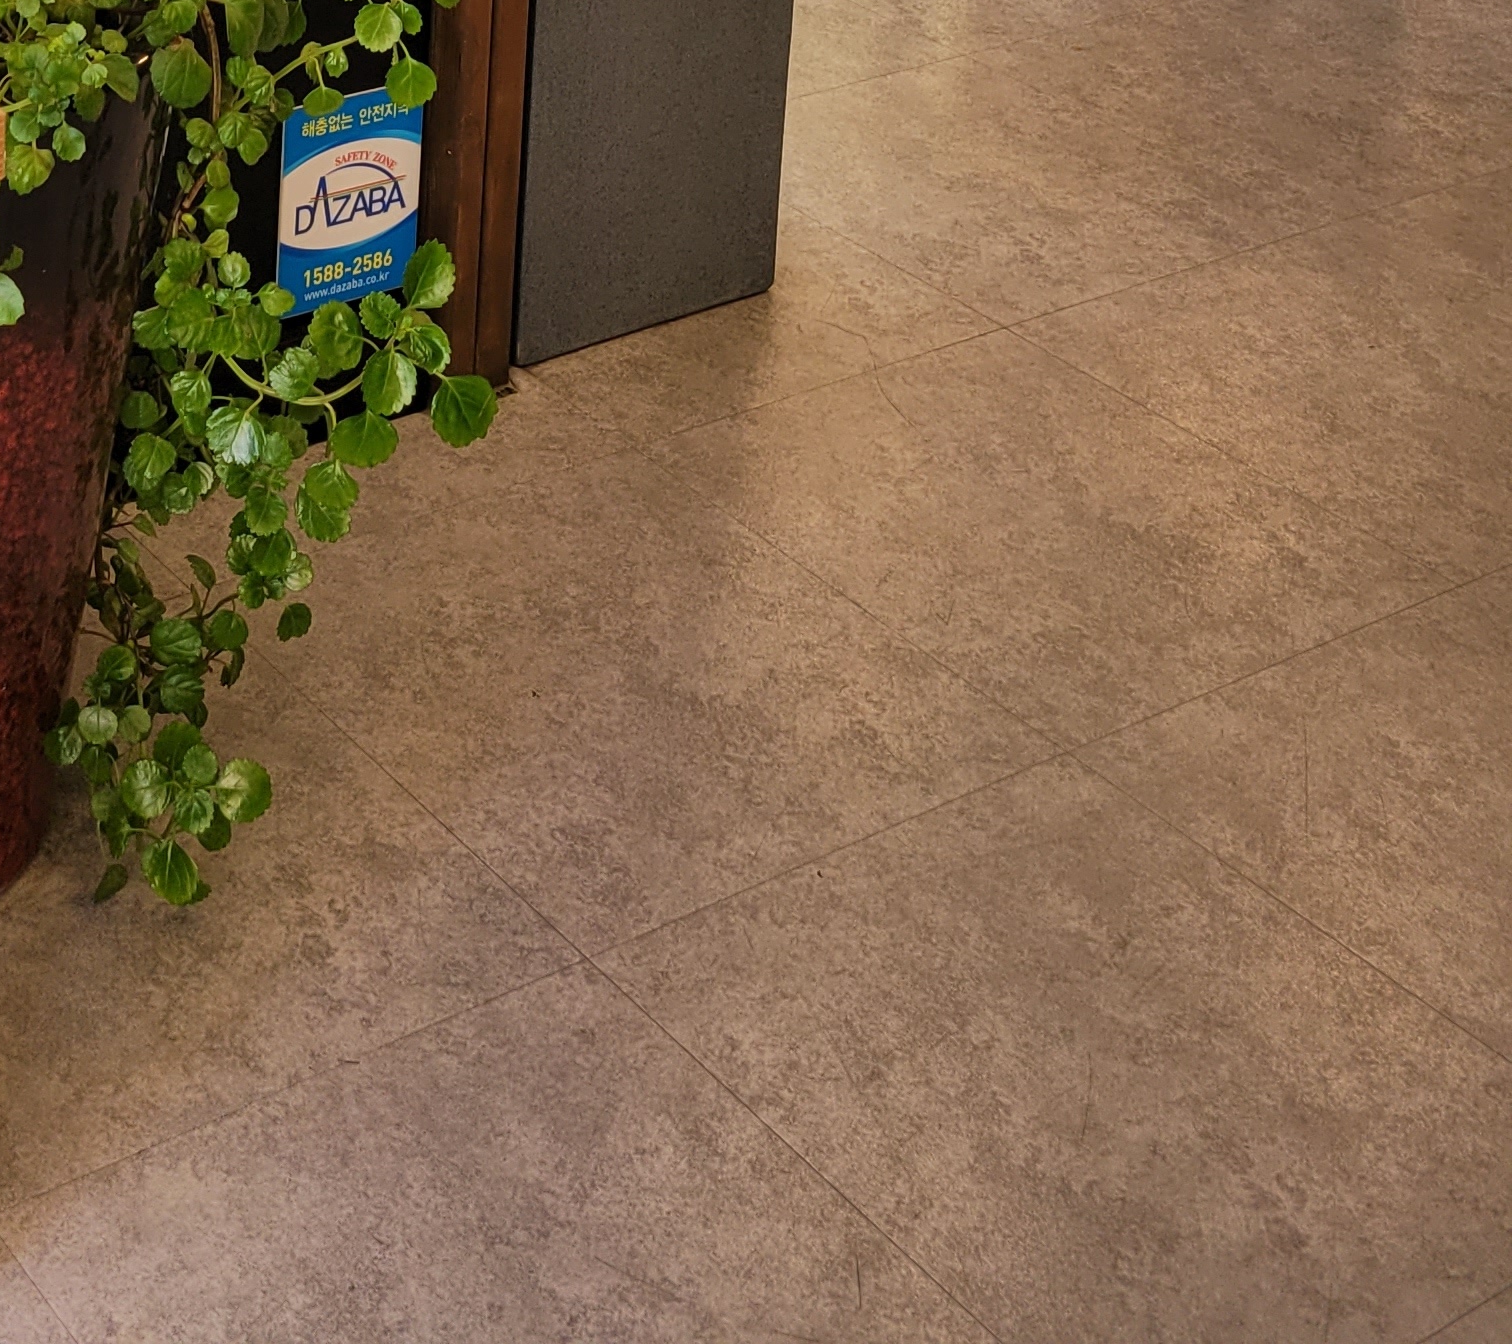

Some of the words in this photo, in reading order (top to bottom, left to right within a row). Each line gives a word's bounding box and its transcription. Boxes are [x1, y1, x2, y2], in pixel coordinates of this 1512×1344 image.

[301, 113, 353, 138] 해충없는
[335, 150, 372, 167] SAFETY
[372, 151, 398, 171] ZONE
[294, 175, 406, 236] DAZABA
[303, 248, 393, 289] 1588-2586
[303, 269, 390, 302] www.dazaba.co.kr
